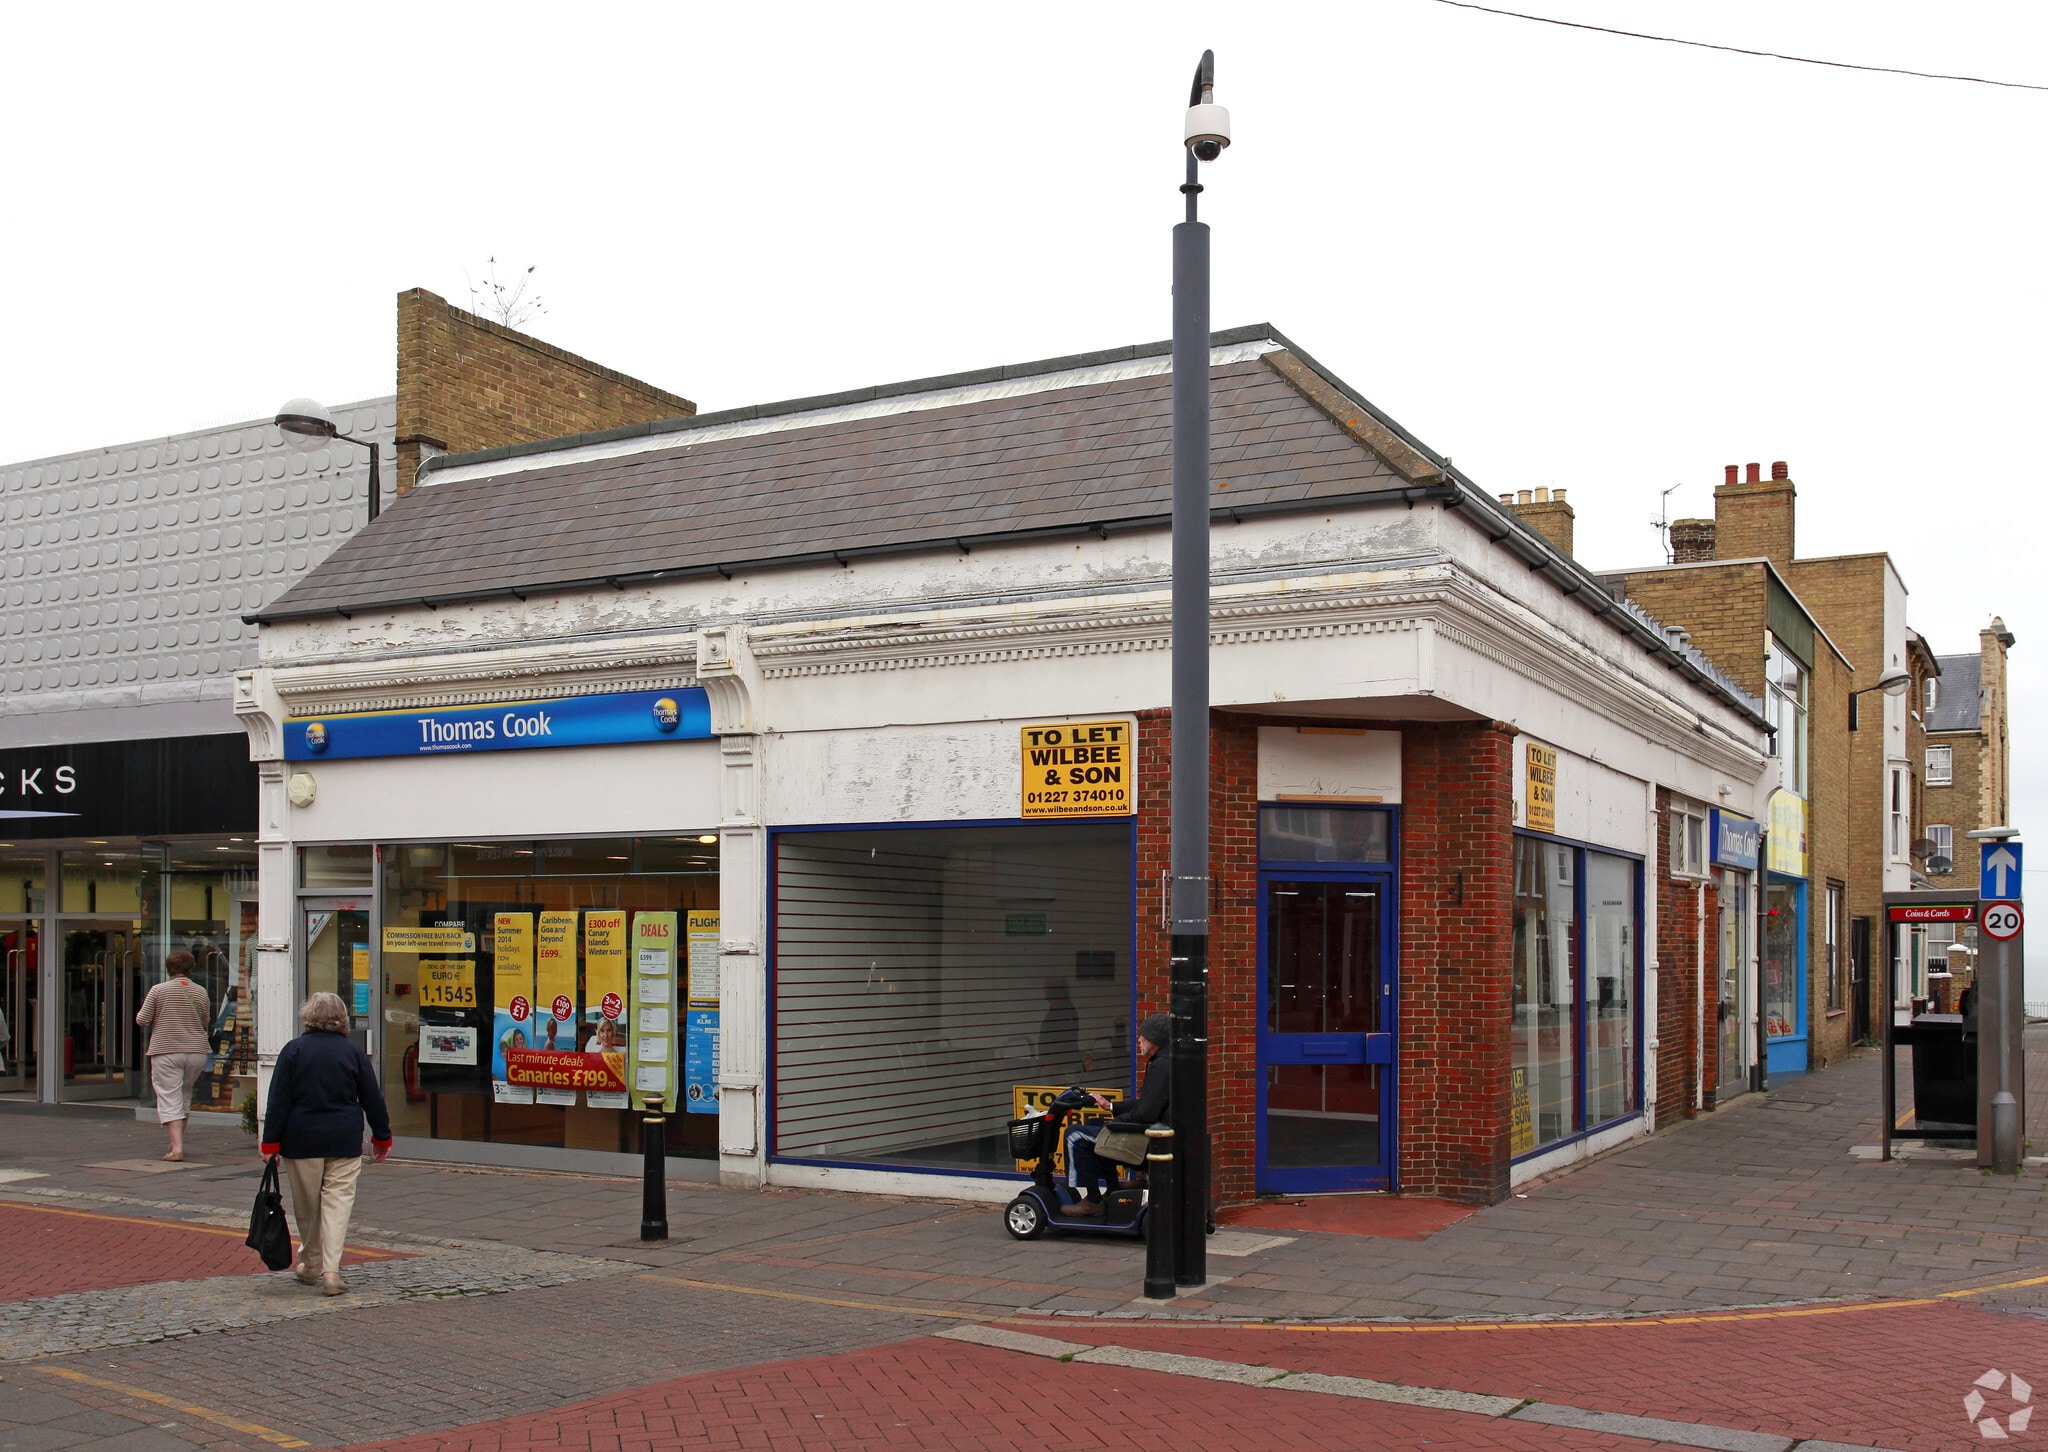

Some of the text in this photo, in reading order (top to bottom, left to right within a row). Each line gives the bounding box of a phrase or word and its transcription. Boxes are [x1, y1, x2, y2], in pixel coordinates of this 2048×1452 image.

[653, 708, 677, 717] Thomas
[660, 715, 677, 724] Cook
[418, 711, 552, 743] Thomas Cook
[310, 737, 325, 745] Cook
[1027, 726, 1123, 746] TO LET
[419, 743, 472, 751] www.thomascook.com
[1030, 746, 1121, 766] WILBEE
[1531, 748, 1556, 767] TO LET
[0, 765, 76, 796] KS
[1044, 766, 1121, 786] & SON
[1530, 766, 1553, 786] WILBEE
[1027, 789, 1125, 804] 01227 374010
[1533, 785, 1553, 804] & SON
[1025, 804, 1128, 814] www.wilbeeandson.co.uk
[1529, 805, 1541, 817] 01227
[1721, 822, 1743, 855] Thomas
[1743, 830, 1757, 858] Cook
[1905, 909, 1950, 918] Coins & Cards
[434, 920, 466, 928] COMPARE
[497, 917, 511, 925] NEW
[541, 916, 573, 925] Caribbean,
[588, 918, 621, 929] £300 off
[1988, 913, 2019, 929] 20
[497, 926, 522, 934] Summer
[540, 926, 567, 934] Goa and
[588, 929, 610, 938] Canary
[641, 923, 669, 938] DEALS
[497, 935, 512, 943] 2014
[540, 935, 564, 944] beyond
[588, 938, 609, 946] Islands
[497, 944, 520, 953] holidays
[540, 949, 559, 958] £699
[588, 948, 608, 956] Winter
[497, 963, 521, 971] available
[432, 971, 460, 980] EURO €
[422, 984, 473, 1003] 1.1545
[555, 998, 570, 1010] £100
[604, 995, 610, 1005] 3
[615, 999, 621, 1009] 2
[511, 1004, 524, 1019] £1
[556, 1006, 567, 1016] off
[507, 1051, 584, 1067] Last minute deals
[508, 1064, 617, 1088] Canaries £199 pp
[494, 1083, 500, 1095] 3
[1022, 1091, 1056, 1107] TO
[1514, 1106, 1531, 1126] SON
